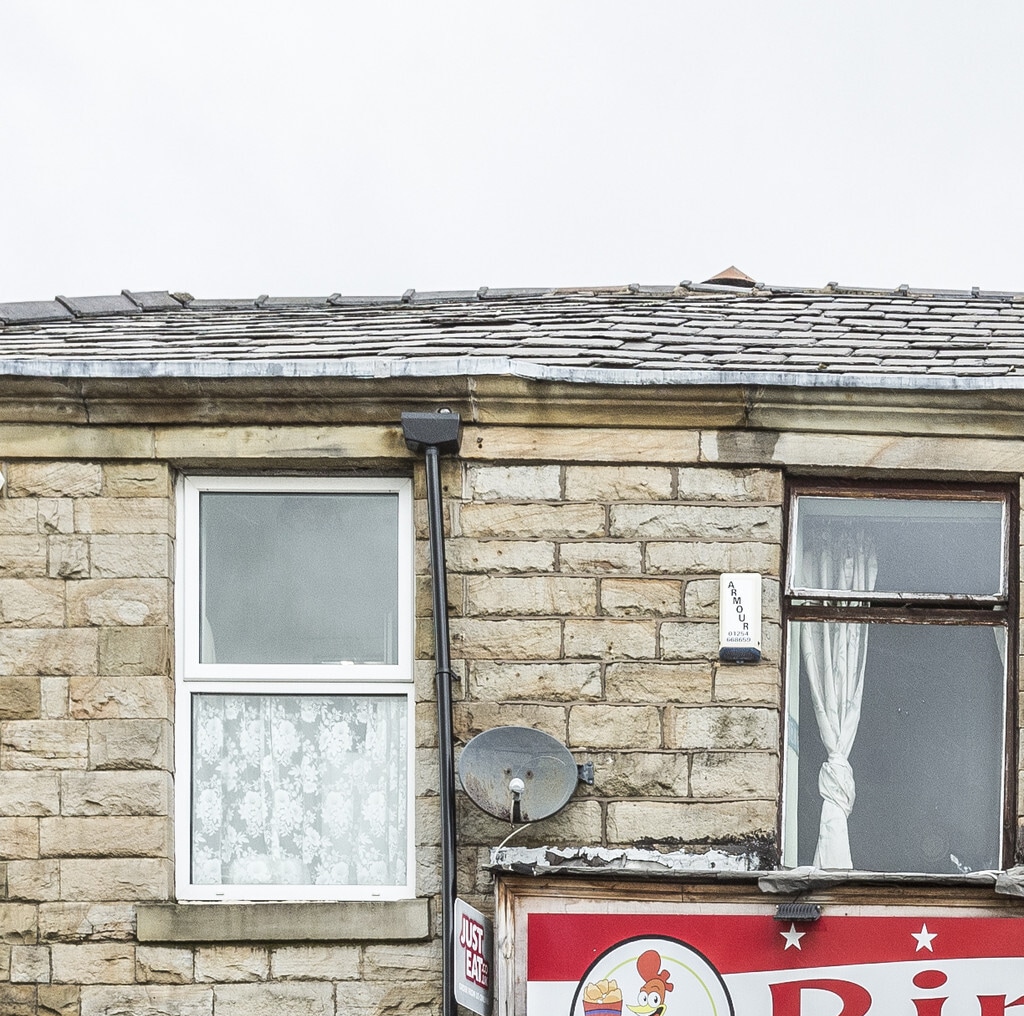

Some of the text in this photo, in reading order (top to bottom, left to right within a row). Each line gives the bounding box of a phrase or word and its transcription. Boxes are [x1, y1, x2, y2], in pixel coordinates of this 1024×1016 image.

[728, 581, 749, 630] ARMOUR
[460, 916, 483, 954] JUST
[466, 949, 483, 983] EAT
